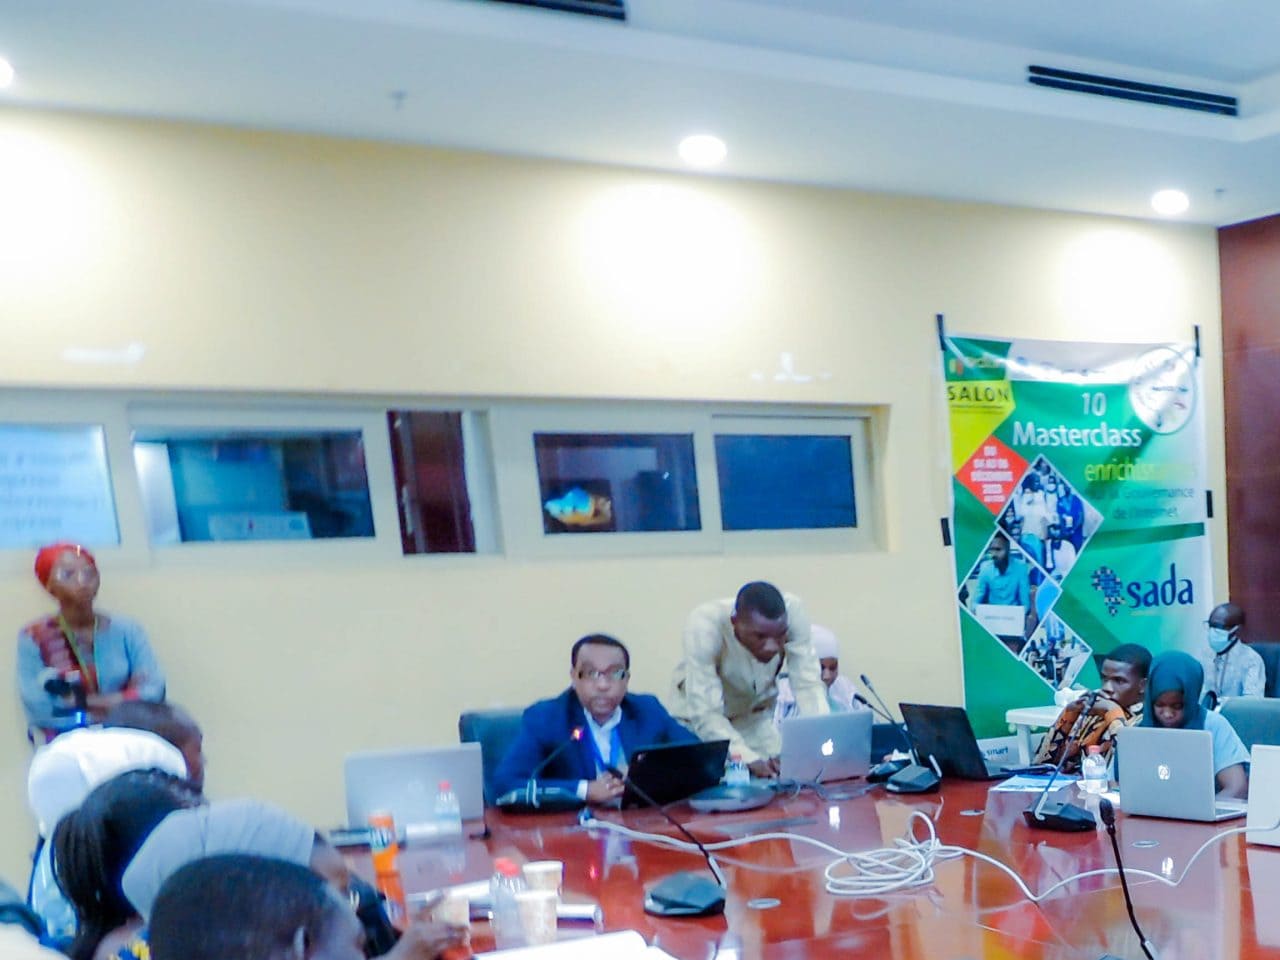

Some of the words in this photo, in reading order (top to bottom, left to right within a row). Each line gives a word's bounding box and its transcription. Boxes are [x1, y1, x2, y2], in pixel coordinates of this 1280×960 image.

[947, 386, 1009, 401] SALON
[1082, 392, 1107, 416] 10
[1012, 421, 1142, 447] Masterclass
[1127, 562, 1194, 608] sada
